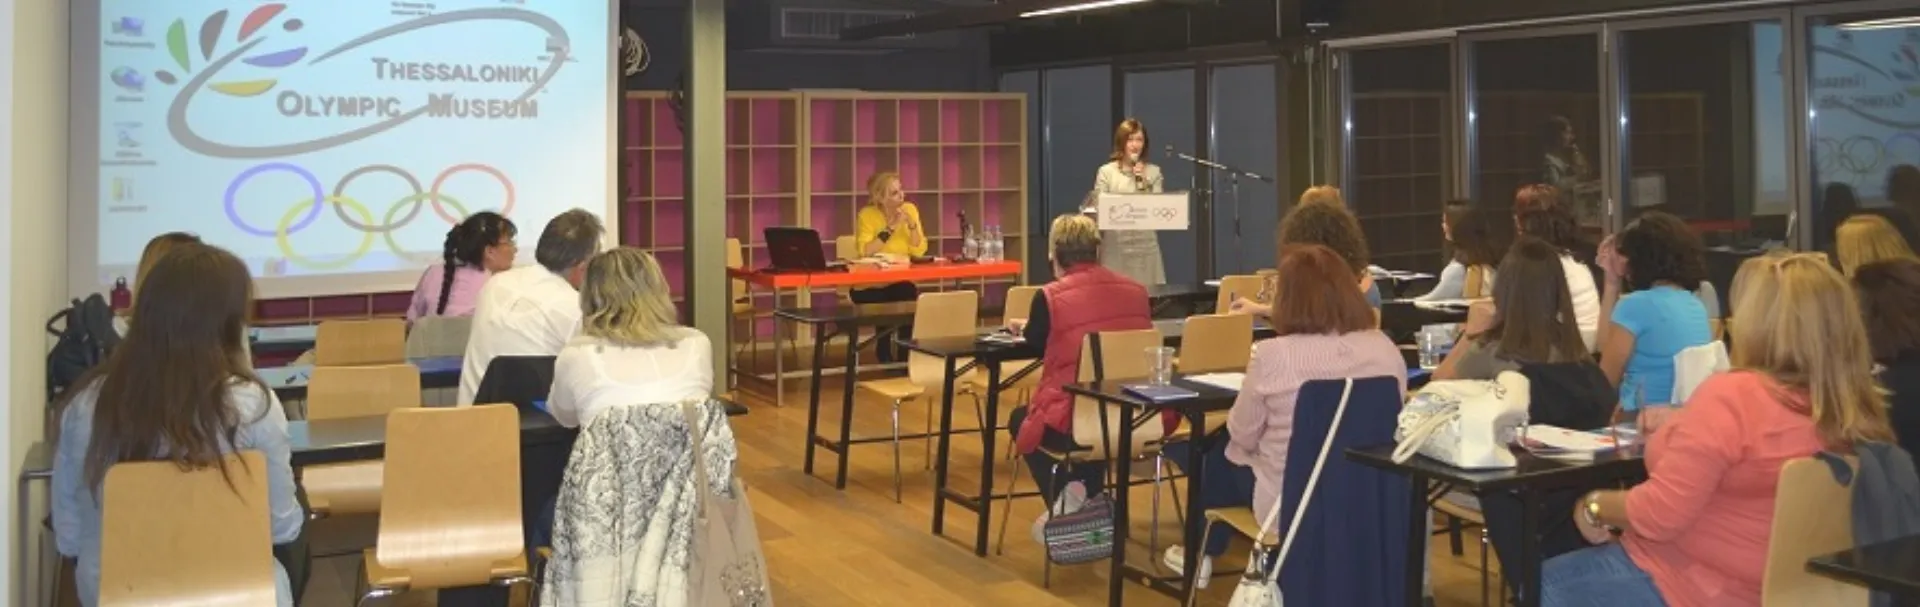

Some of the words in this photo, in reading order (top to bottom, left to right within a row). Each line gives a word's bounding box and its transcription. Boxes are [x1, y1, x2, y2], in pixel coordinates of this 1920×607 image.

[372, 57, 539, 84] THESSALONIKI
[277, 90, 401, 118] OLYMPIC
[428, 92, 539, 119] MUSEUM
